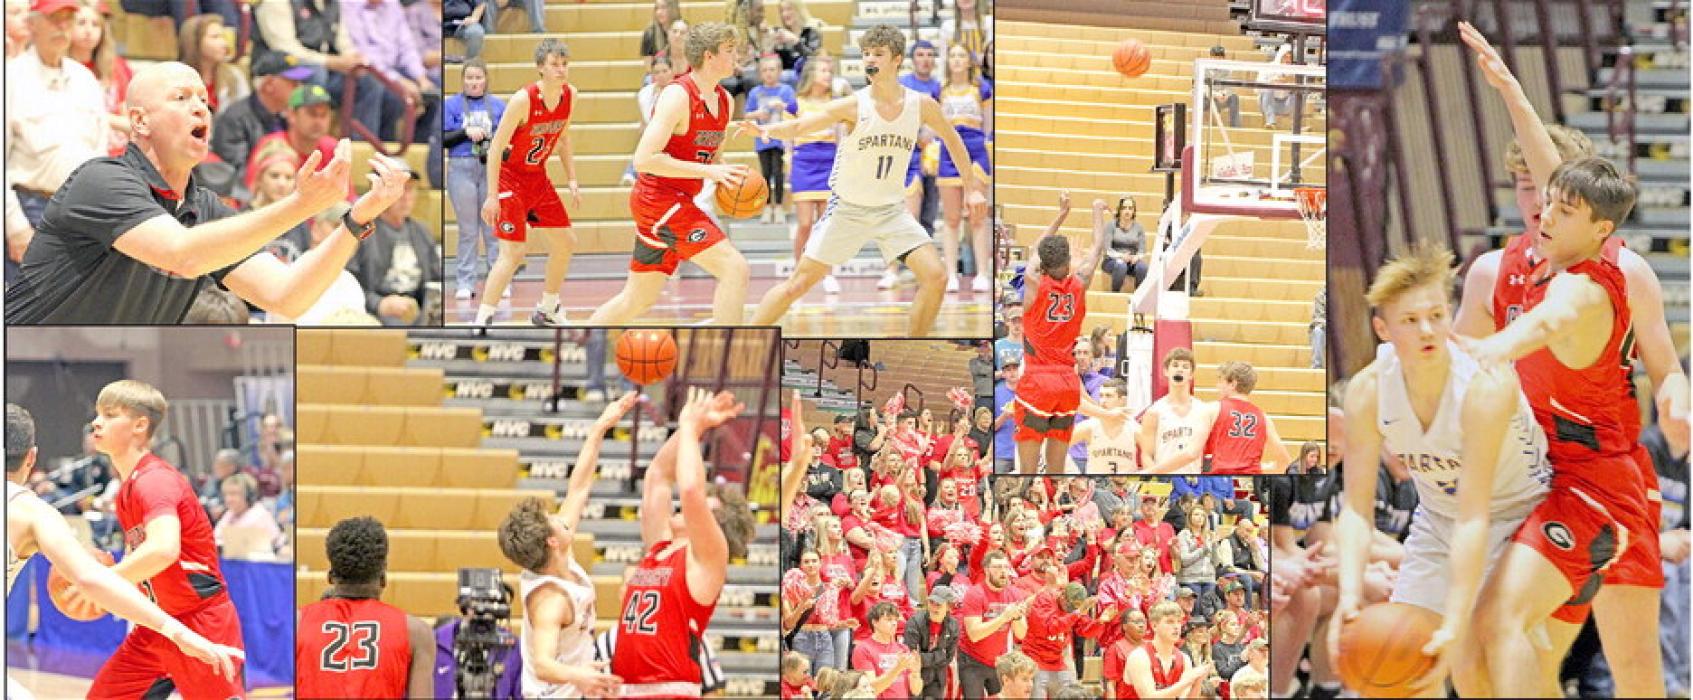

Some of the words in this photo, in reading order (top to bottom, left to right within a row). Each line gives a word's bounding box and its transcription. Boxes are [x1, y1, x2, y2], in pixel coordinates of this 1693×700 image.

[876, 155, 894, 180] 11
[1045, 291, 1075, 323] 23
[420, 343, 457, 360] NVC
[488, 343, 525, 360] NVC
[456, 382, 493, 398] NVC
[492, 420, 531, 437] NVC
[1228, 410, 1257, 438] 32
[531, 462, 568, 478] NVC
[622, 589, 661, 635] 42
[320, 620, 380, 672] 23
[726, 678, 765, 696] NVC
